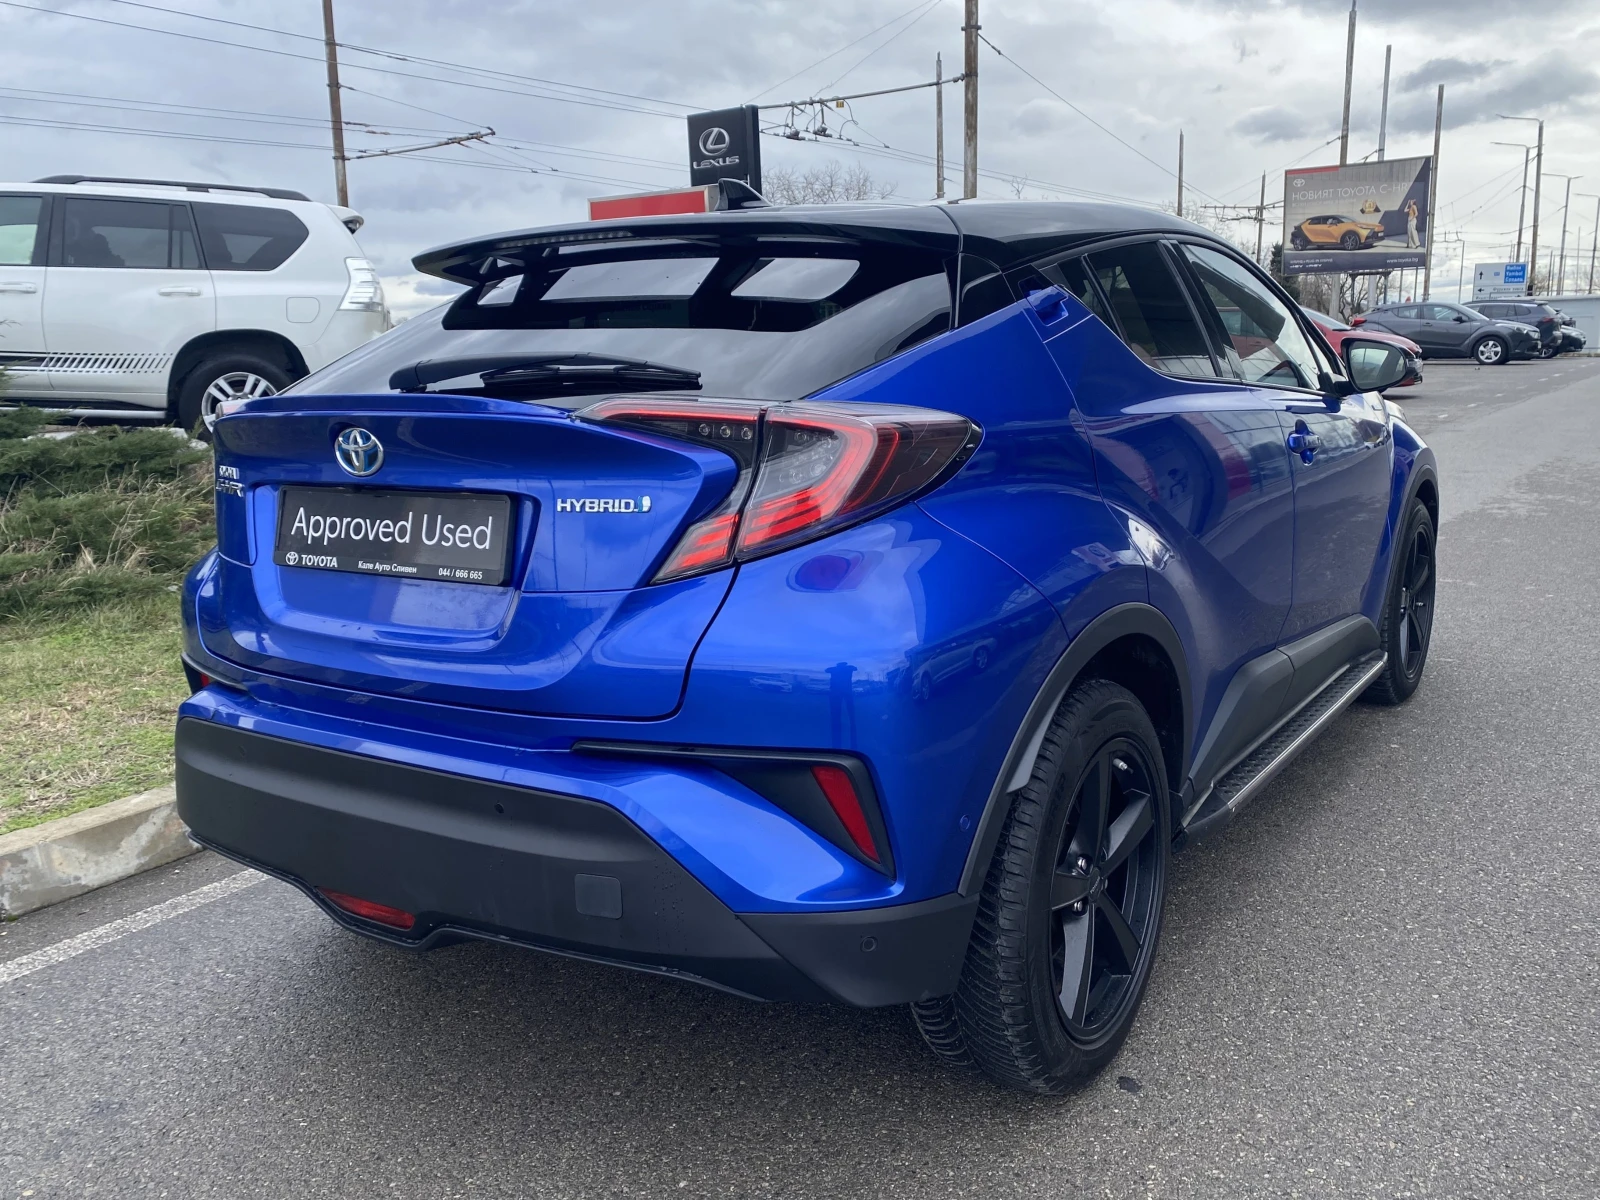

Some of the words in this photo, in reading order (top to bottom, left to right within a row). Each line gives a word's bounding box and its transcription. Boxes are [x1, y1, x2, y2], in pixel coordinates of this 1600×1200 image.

[693, 155, 740, 169] LEXUS
[1292, 189, 1333, 201] НОВИЯТ
[1336, 185, 1376, 197] TOYOTA
[1379, 182, 1408, 194] C-HR
[556, 498, 635, 513] HYBRID
[290, 506, 413, 546] Approved
[421, 513, 493, 550] Used
[301, 554, 338, 568] TOYOTA
[358, 560, 374, 570] Кале
[374, 562, 390, 572] Ауто
[391, 563, 417, 573] Сливен
[438, 567, 450, 577] 044
[455, 569, 468, 578] 666
[469, 570, 482, 579] 665
